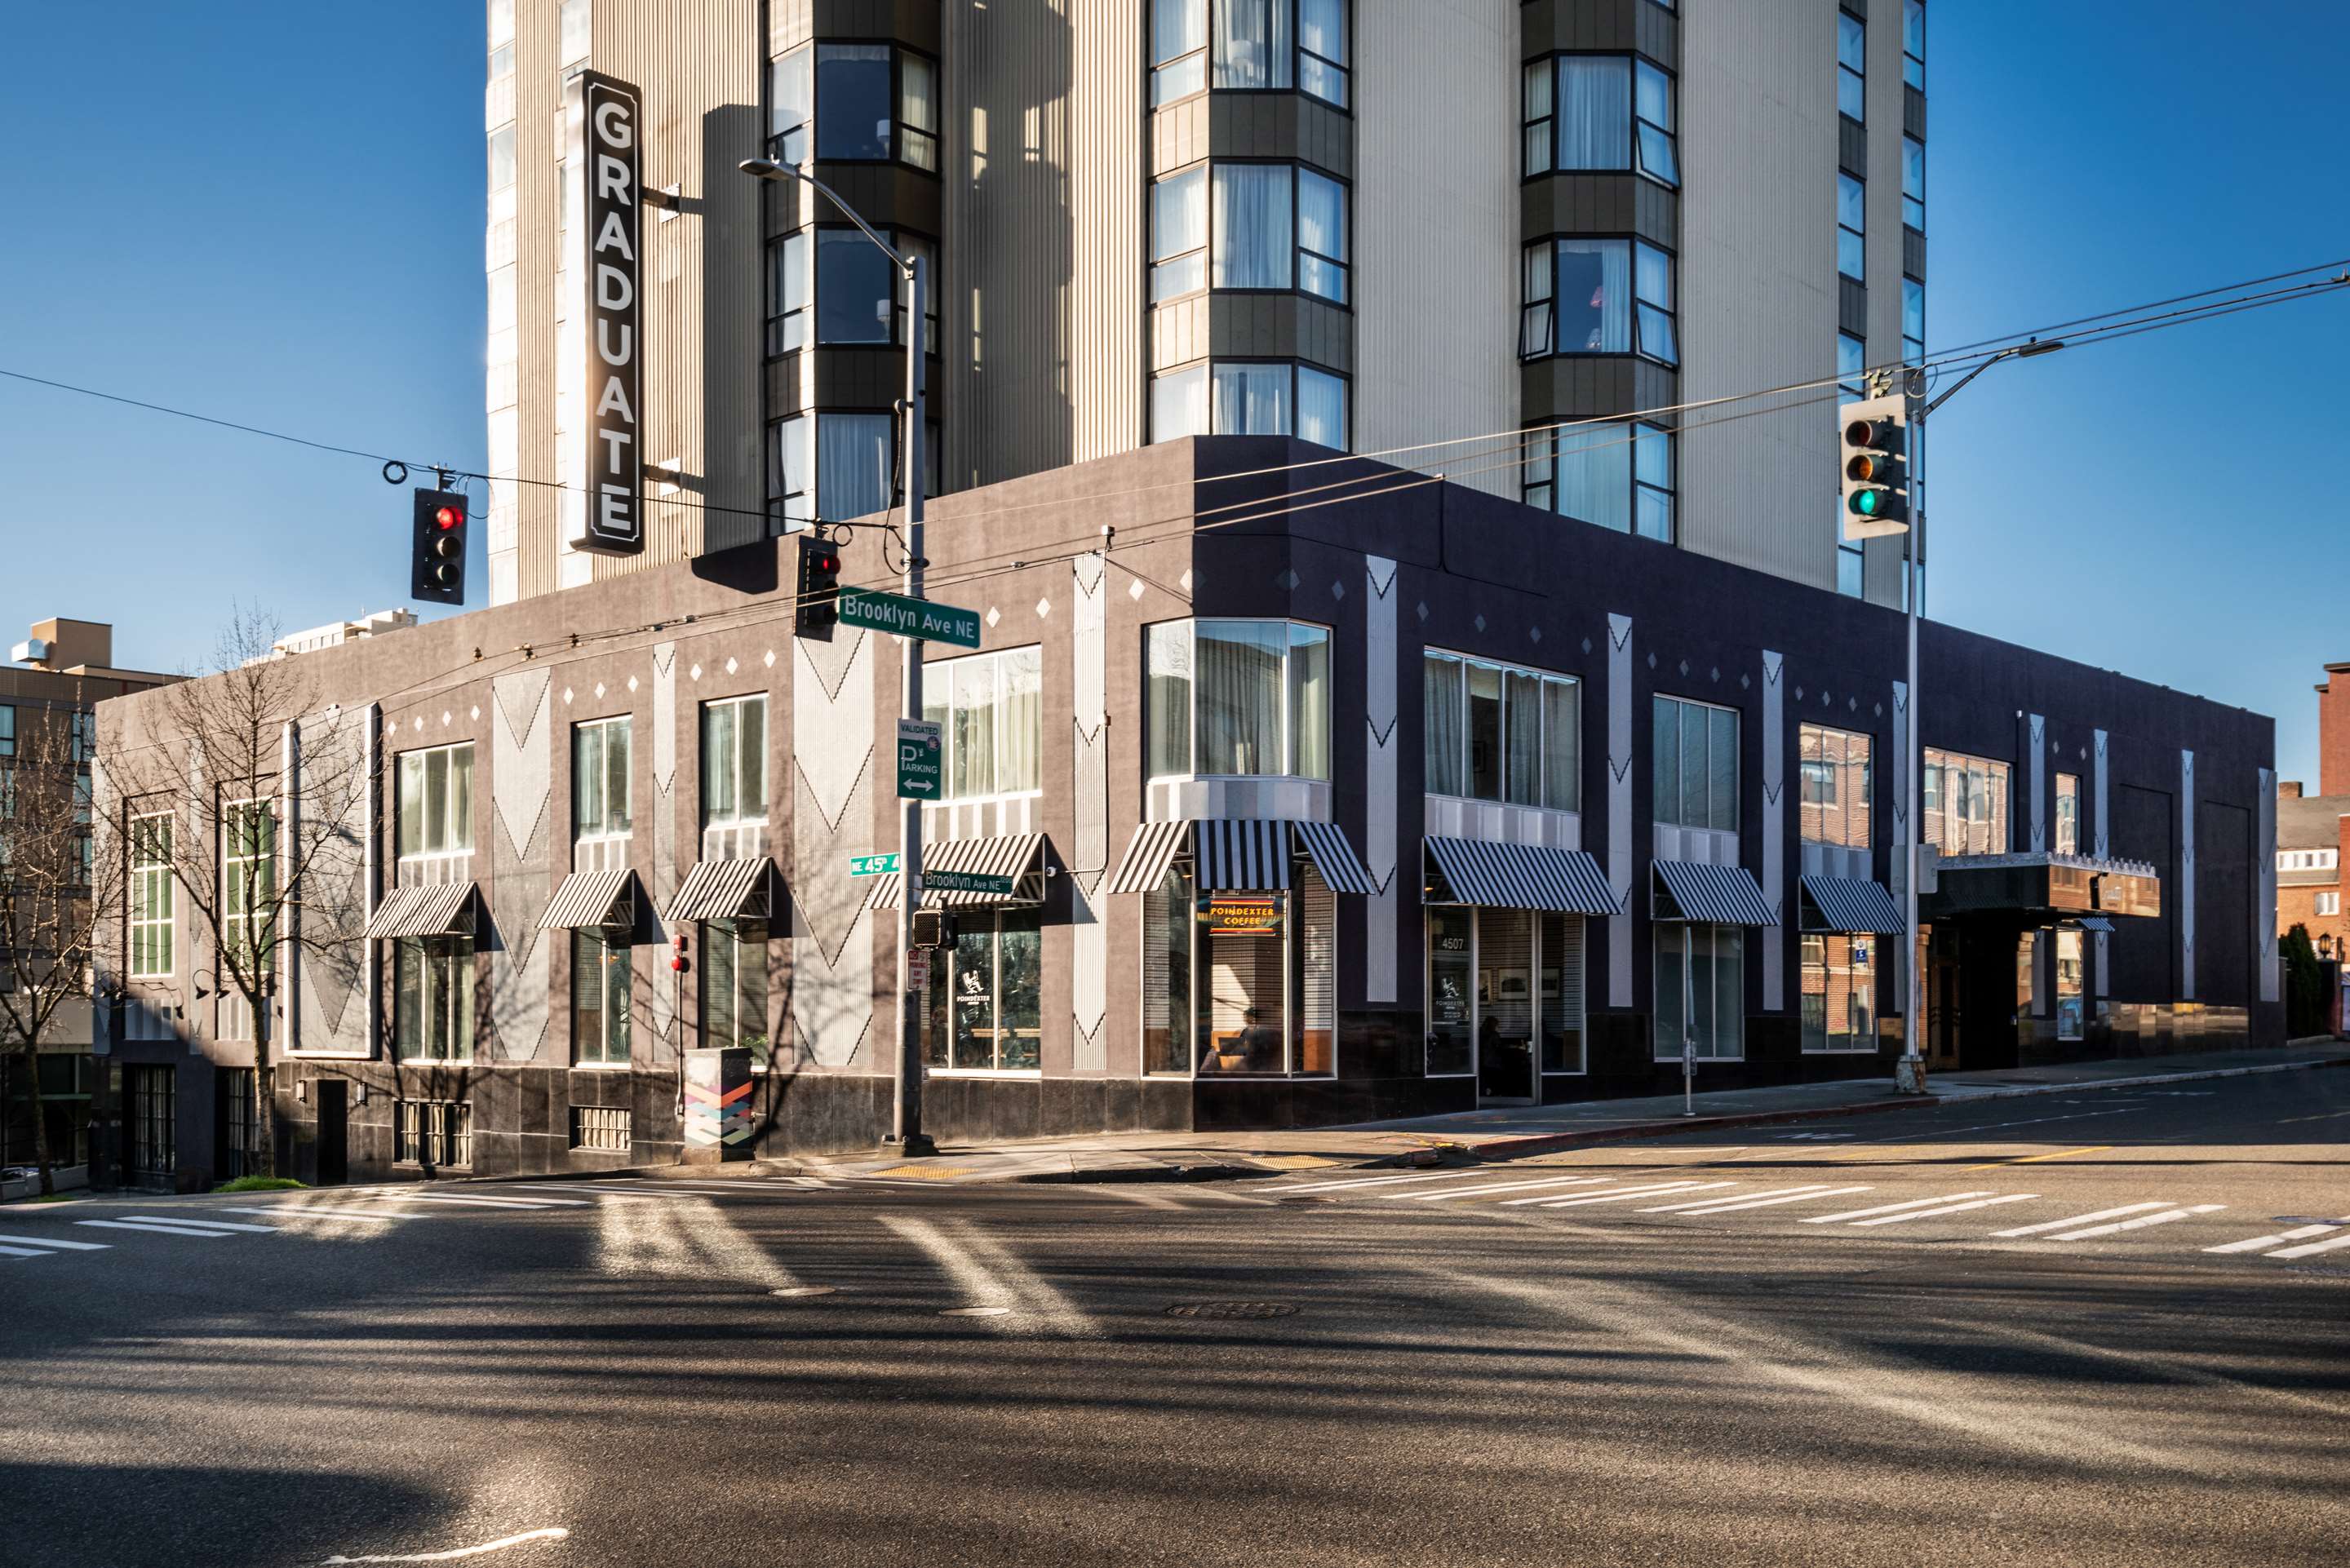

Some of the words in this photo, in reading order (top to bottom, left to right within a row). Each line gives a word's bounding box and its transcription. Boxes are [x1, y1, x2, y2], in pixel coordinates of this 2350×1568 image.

[594, 101, 634, 531] GRADUATE
[845, 595, 916, 630] Brooklyn
[922, 613, 951, 633] Ave
[956, 620, 975, 639] NE
[900, 724, 938, 735] VALIDATED
[901, 745, 938, 774] PARKING
[852, 862, 863, 872] NE
[925, 871, 971, 890] Brooklyn
[973, 879, 987, 889] Ave
[989, 880, 1001, 890] NE
[1210, 907, 1274, 915] POINDEXTER
[1224, 917, 1261, 925] COFFEE
[1442, 937, 1464, 950] 4507
